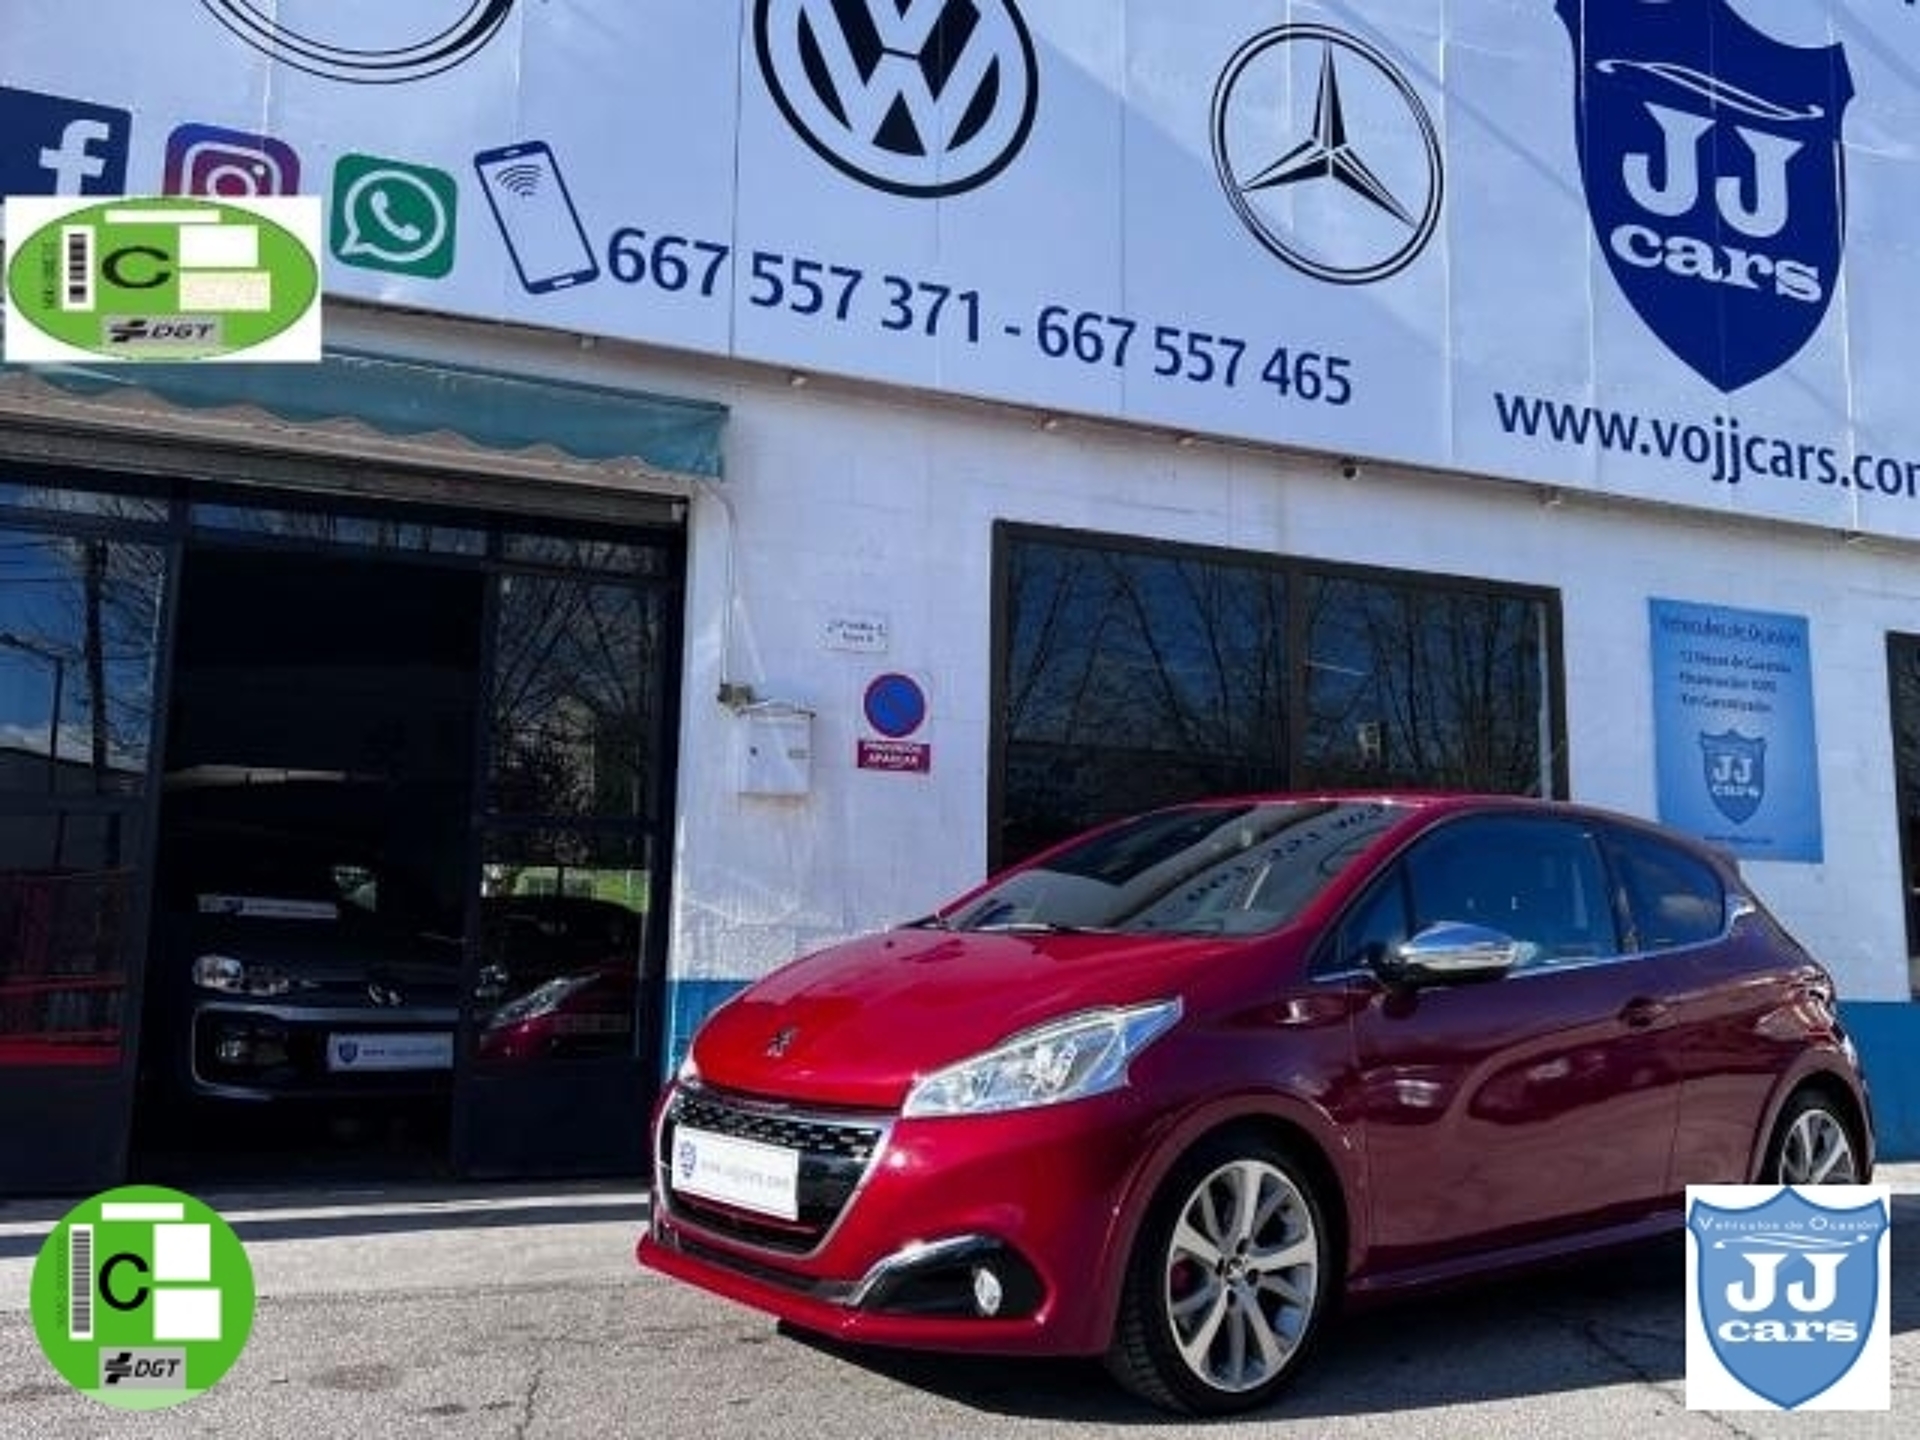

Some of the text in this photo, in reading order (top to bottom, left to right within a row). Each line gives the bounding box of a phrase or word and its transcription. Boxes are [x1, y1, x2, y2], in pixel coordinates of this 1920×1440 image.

[1622, 101, 1804, 238] JJ
[607, 227, 730, 297] 667
[750, 251, 863, 321] 557
[881, 275, 979, 343] 371
[1037, 305, 1137, 368] 667
[1154, 325, 1246, 387] 557
[1261, 347, 1352, 406] 465
[1610, 224, 1822, 302] cars
